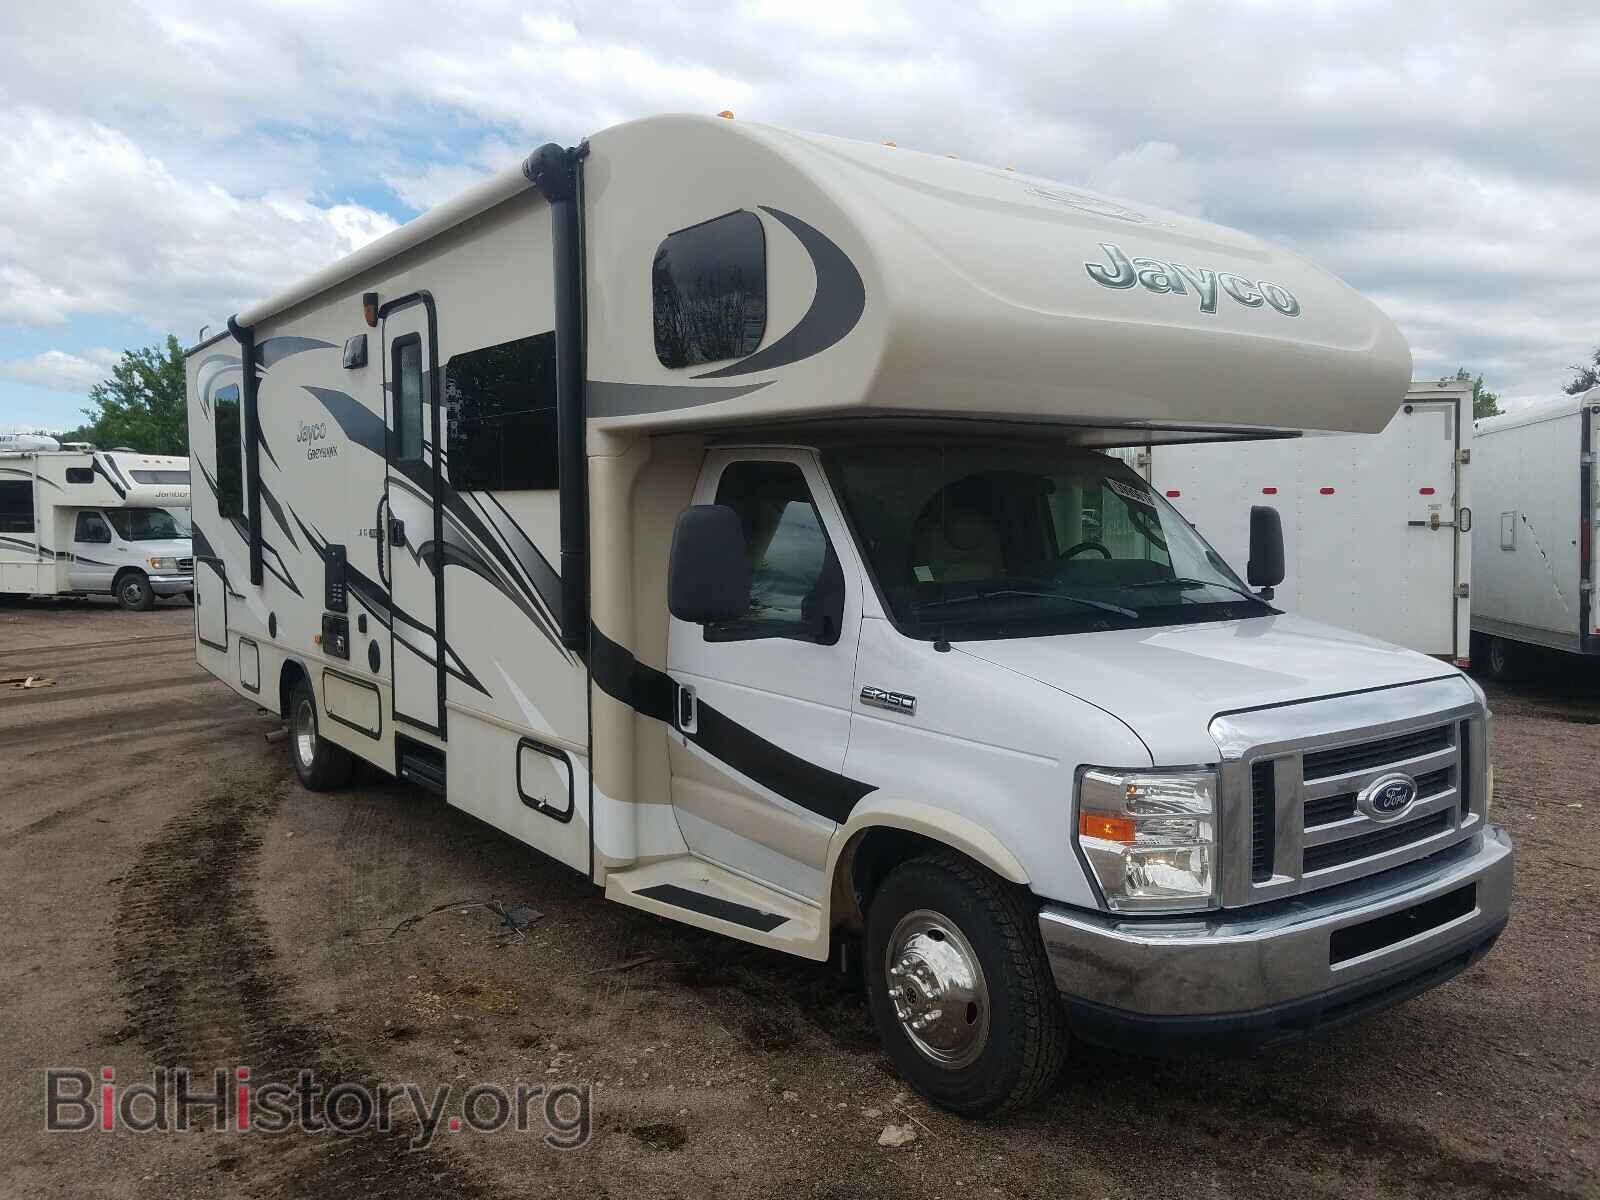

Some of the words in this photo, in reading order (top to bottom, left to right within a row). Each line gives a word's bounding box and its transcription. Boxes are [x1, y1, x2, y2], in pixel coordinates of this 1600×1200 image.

[1085, 242, 1302, 317] Jayco
[296, 420, 327, 446] Jayco
[1383, 786, 1408, 808] Ford
